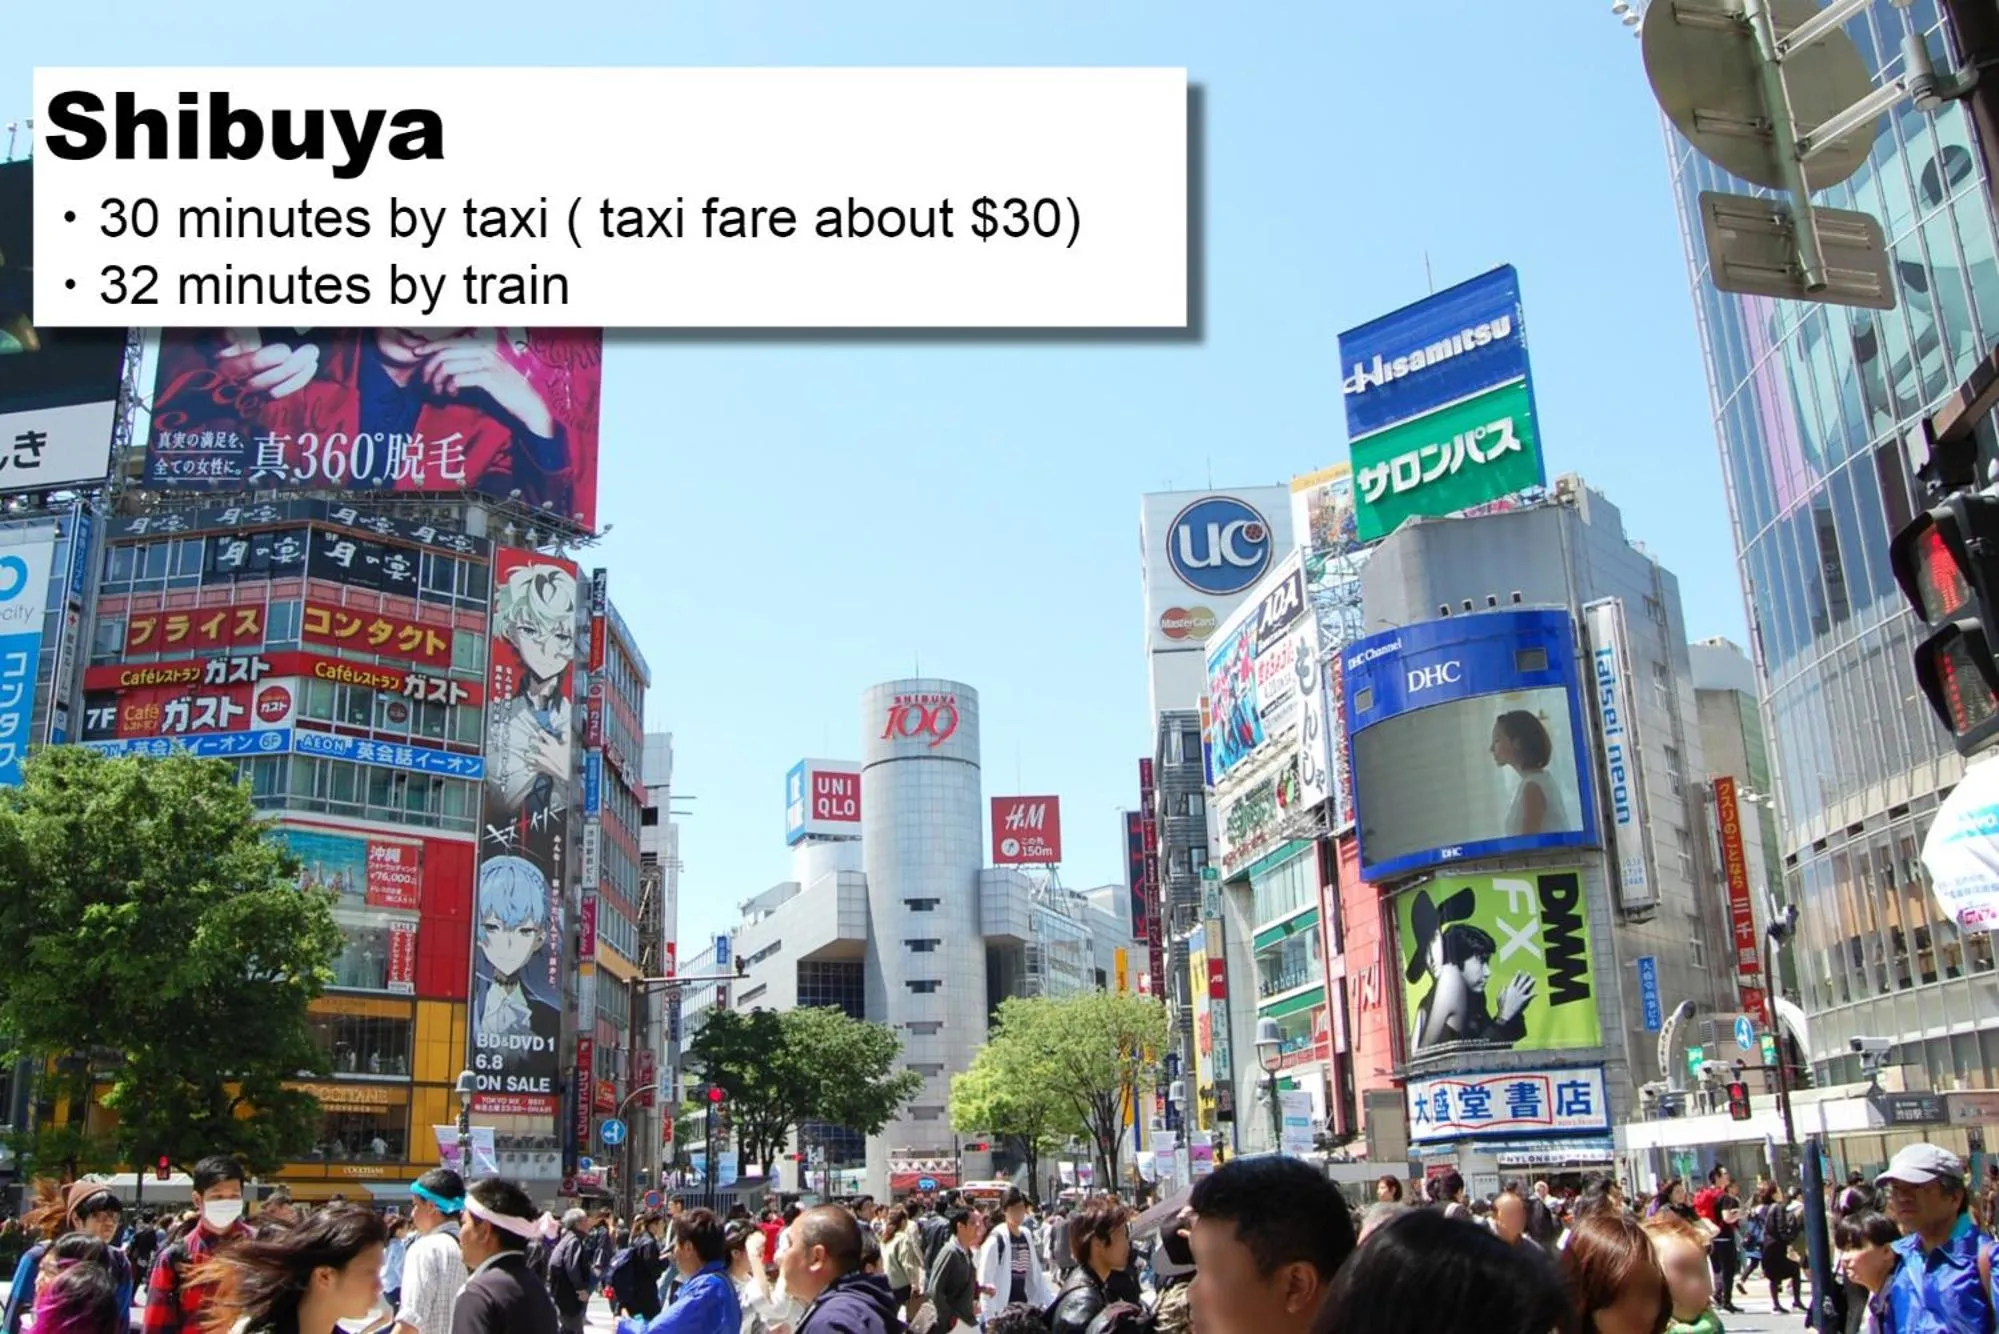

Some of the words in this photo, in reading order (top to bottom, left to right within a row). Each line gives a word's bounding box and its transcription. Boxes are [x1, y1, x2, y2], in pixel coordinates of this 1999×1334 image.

[1343, 315, 1511, 393] Hisamitsu
[1357, 416, 1521, 504] サロンパス
[130, 609, 261, 646] プライス
[304, 607, 447, 657] コンタクト
[1365, 638, 1403, 662] Channel
[205, 656, 270, 685] ガスト
[1407, 661, 1461, 693] DHC
[402, 675, 469, 705] ガスト
[894, 694, 956, 704] SHIBUYA
[87, 707, 117, 729] 7F
[124, 702, 160, 721] Café
[161, 695, 243, 733] ガスト
[881, 703, 960, 748] 109
[304, 735, 347, 754] AEON
[357, 743, 481, 774] 英会話イーオン
[818, 775, 852, 796] UNI
[1607, 744, 1631, 825] neon
[818, 798, 855, 818] QLO
[1005, 802, 1046, 831] H&M
[1021, 846, 1053, 857] 150m
[1442, 846, 1463, 859] DHC
[1492, 877, 1543, 964] FX
[1537, 872, 1591, 1008] DMM
[476, 1033, 544, 1052] BD&DVD
[547, 1036, 555, 1052] 1
[475, 1054, 503, 1070] 6.8
[476, 1075, 502, 1092] ON
[506, 1075, 551, 1093] SALE
[1414, 1080, 1593, 1126] 大盛堂書店
